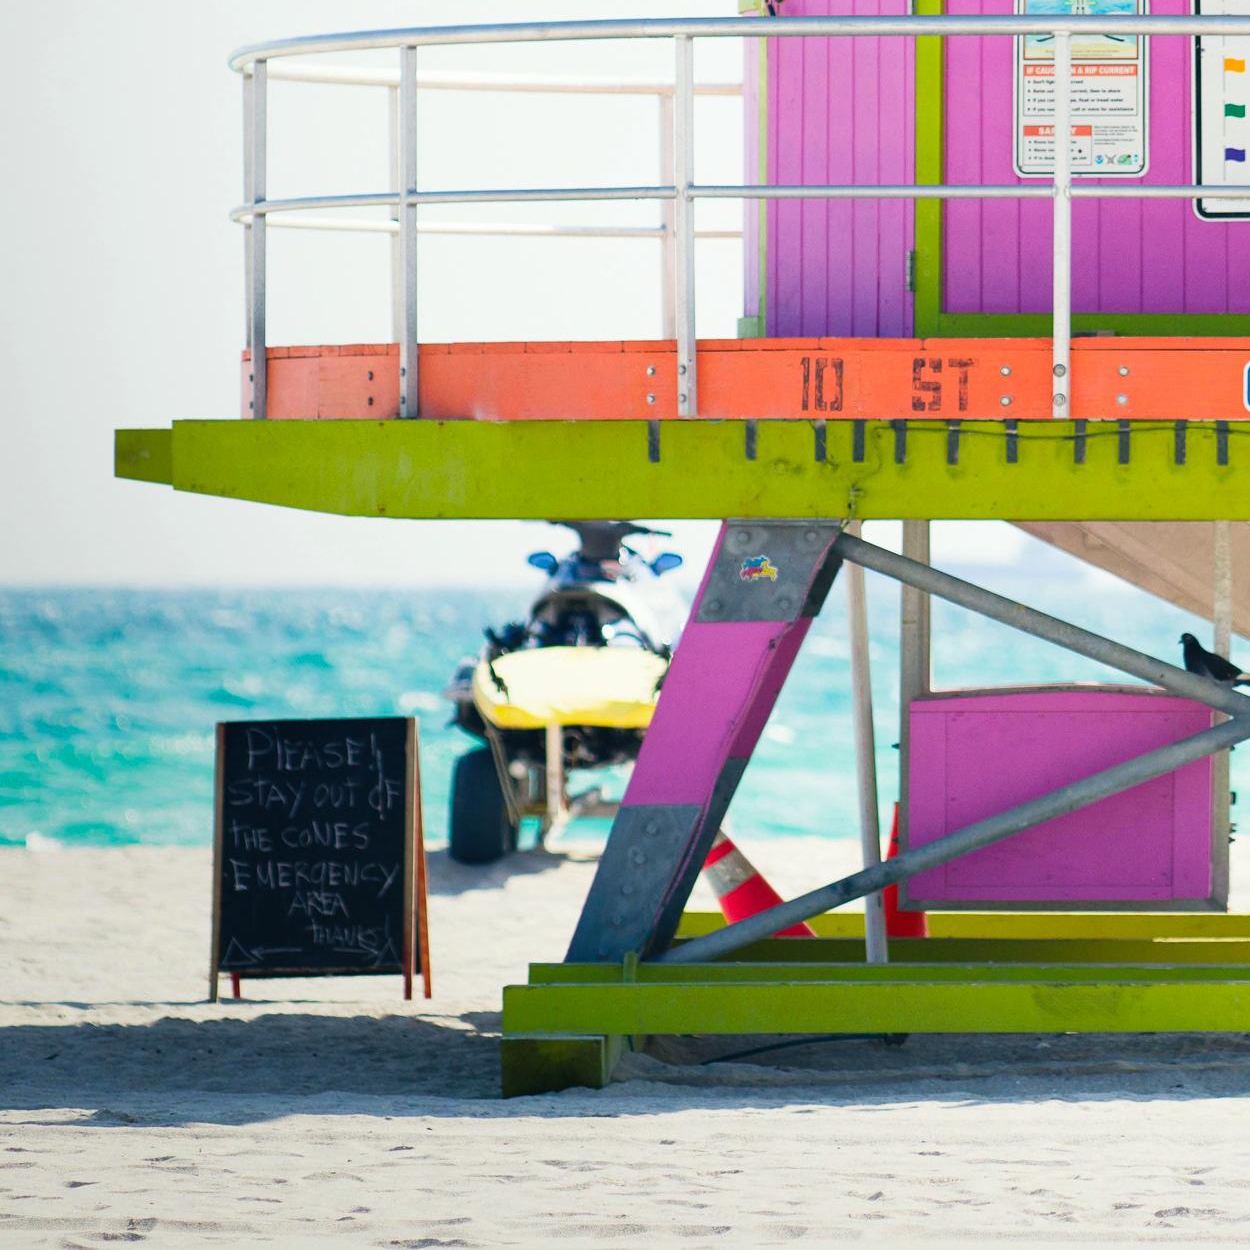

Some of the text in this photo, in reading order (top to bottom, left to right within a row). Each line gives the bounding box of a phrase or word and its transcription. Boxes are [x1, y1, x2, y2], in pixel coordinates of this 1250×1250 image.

[800, 357, 976, 412] 10 ST
[227, 775, 402, 818] STAY OUT OF
[229, 819, 370, 852] THE CONES
[229, 858, 401, 899] EMERGENCY
[287, 889, 349, 918] AREA
